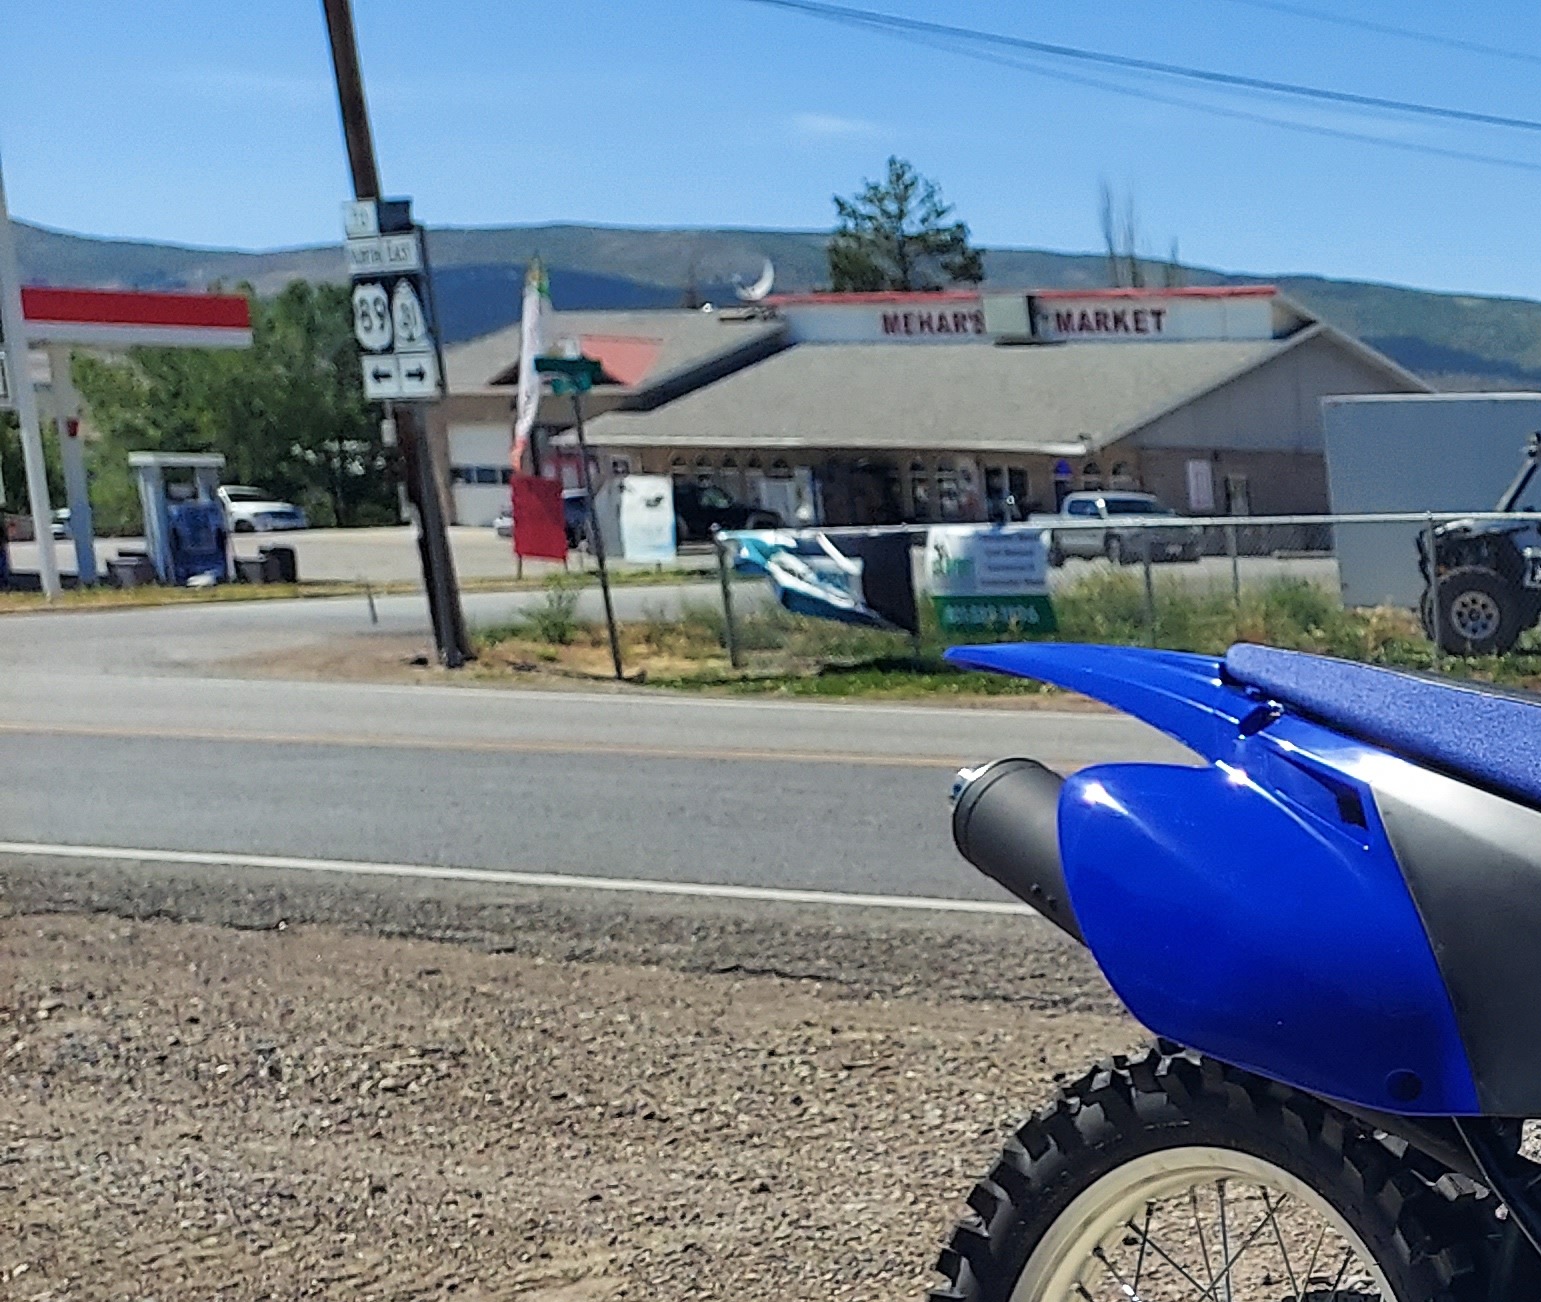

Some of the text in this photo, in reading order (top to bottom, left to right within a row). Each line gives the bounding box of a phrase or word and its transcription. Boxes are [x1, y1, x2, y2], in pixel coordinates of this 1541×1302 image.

[358, 296, 386, 334] 89
[881, 309, 1166, 335] MEHAR'S MARKET
